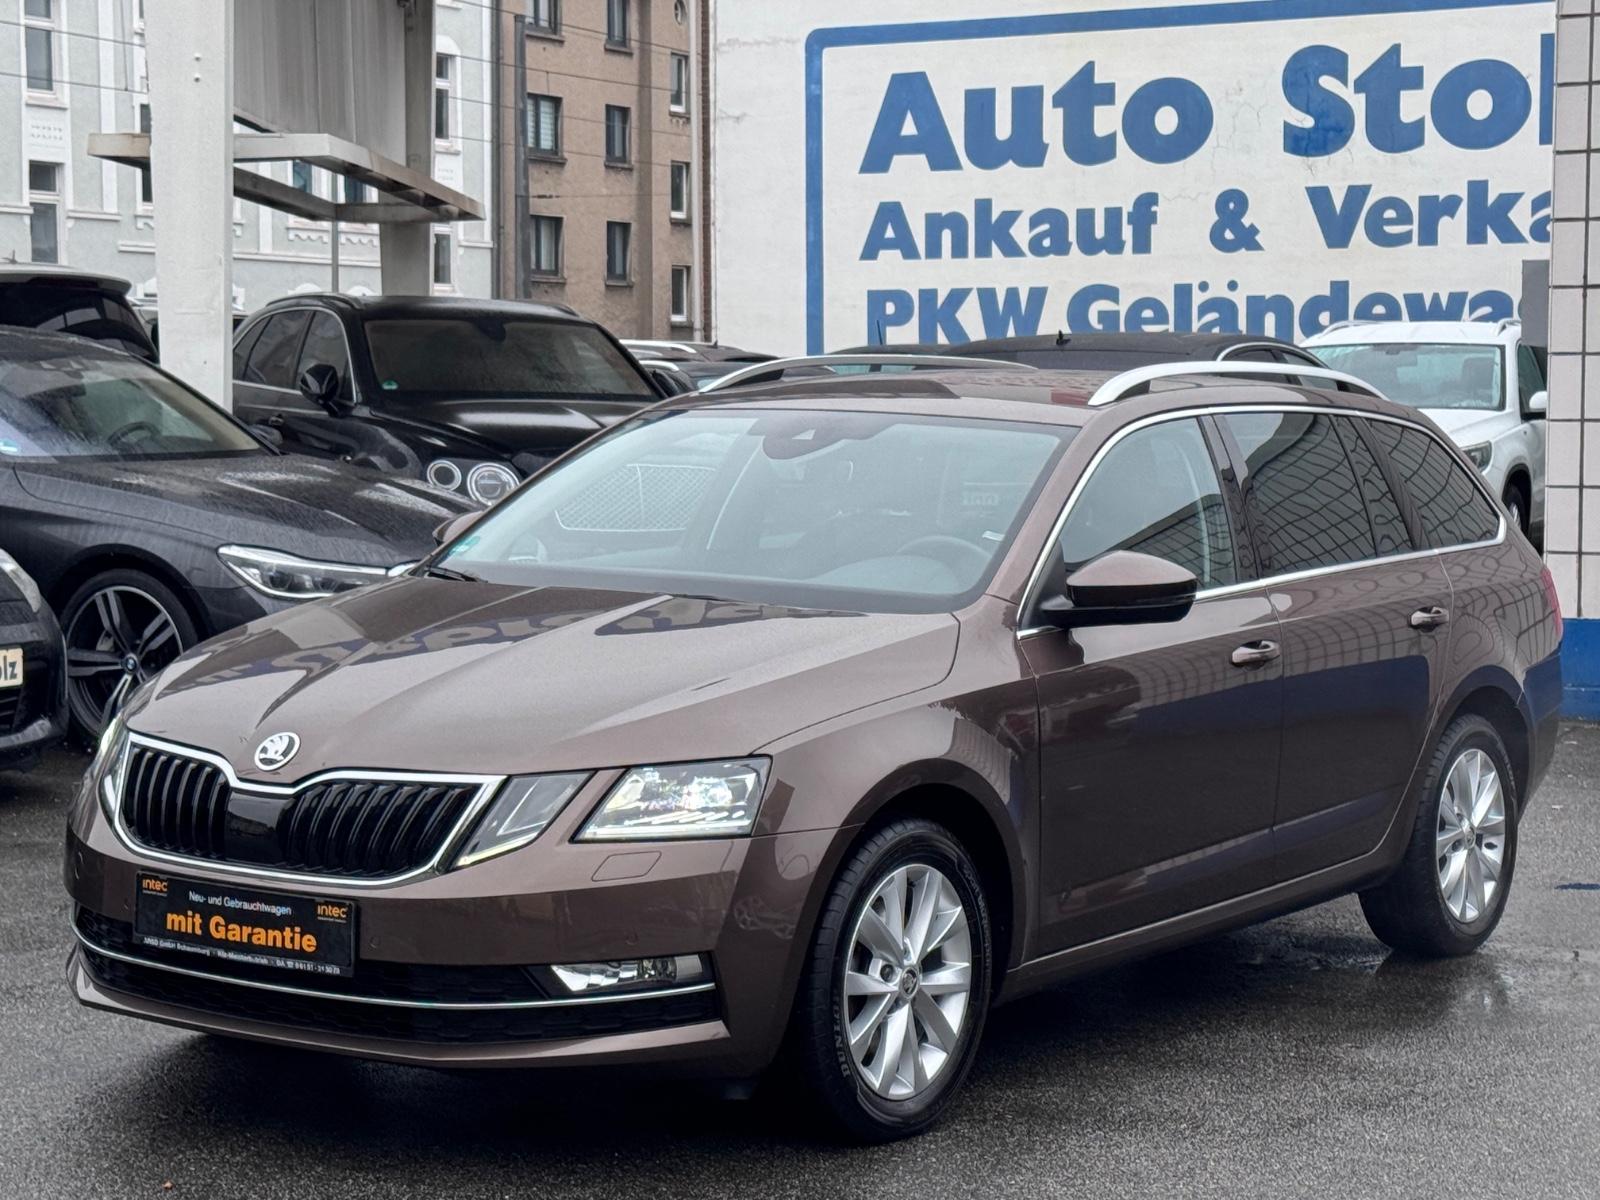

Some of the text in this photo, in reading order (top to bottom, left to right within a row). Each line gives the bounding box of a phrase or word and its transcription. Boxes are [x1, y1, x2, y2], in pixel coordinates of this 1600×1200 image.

[859, 61, 1214, 174] Auto
[859, 192, 1159, 261] Ankauf
[1209, 189, 1265, 254] &
[867, 280, 1523, 346] PKW Geländewa
[0, 655, 17, 681] lz
[142, 878, 168, 892] intec
[189, 890, 292, 917] Neu- und Gebrauchtwagen
[317, 904, 348, 919] intec
[166, 910, 202, 935] mit
[209, 915, 317, 953] Garantie
